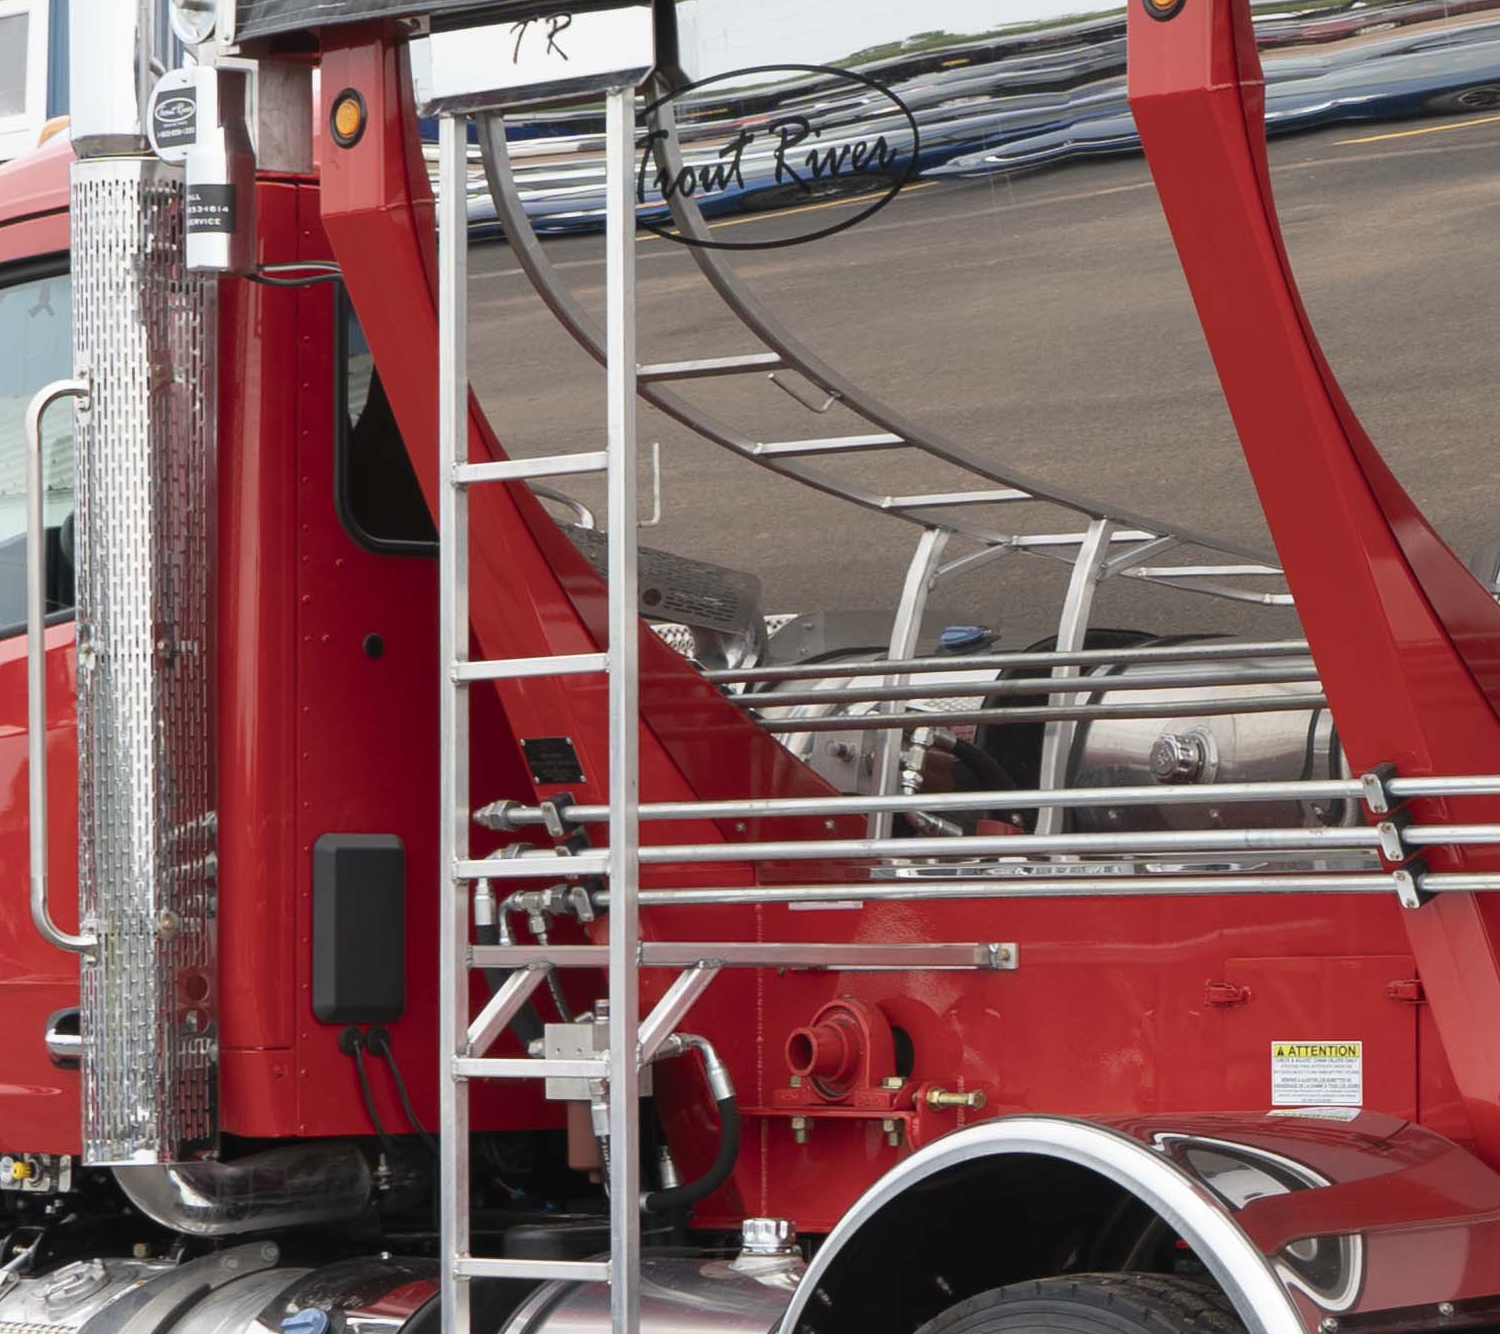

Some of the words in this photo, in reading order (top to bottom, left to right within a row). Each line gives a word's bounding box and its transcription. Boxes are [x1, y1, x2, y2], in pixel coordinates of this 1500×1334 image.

[633, 128, 755, 204] Trout
[768, 115, 899, 194] River
[1287, 1045, 1357, 1057] ATTENTION
